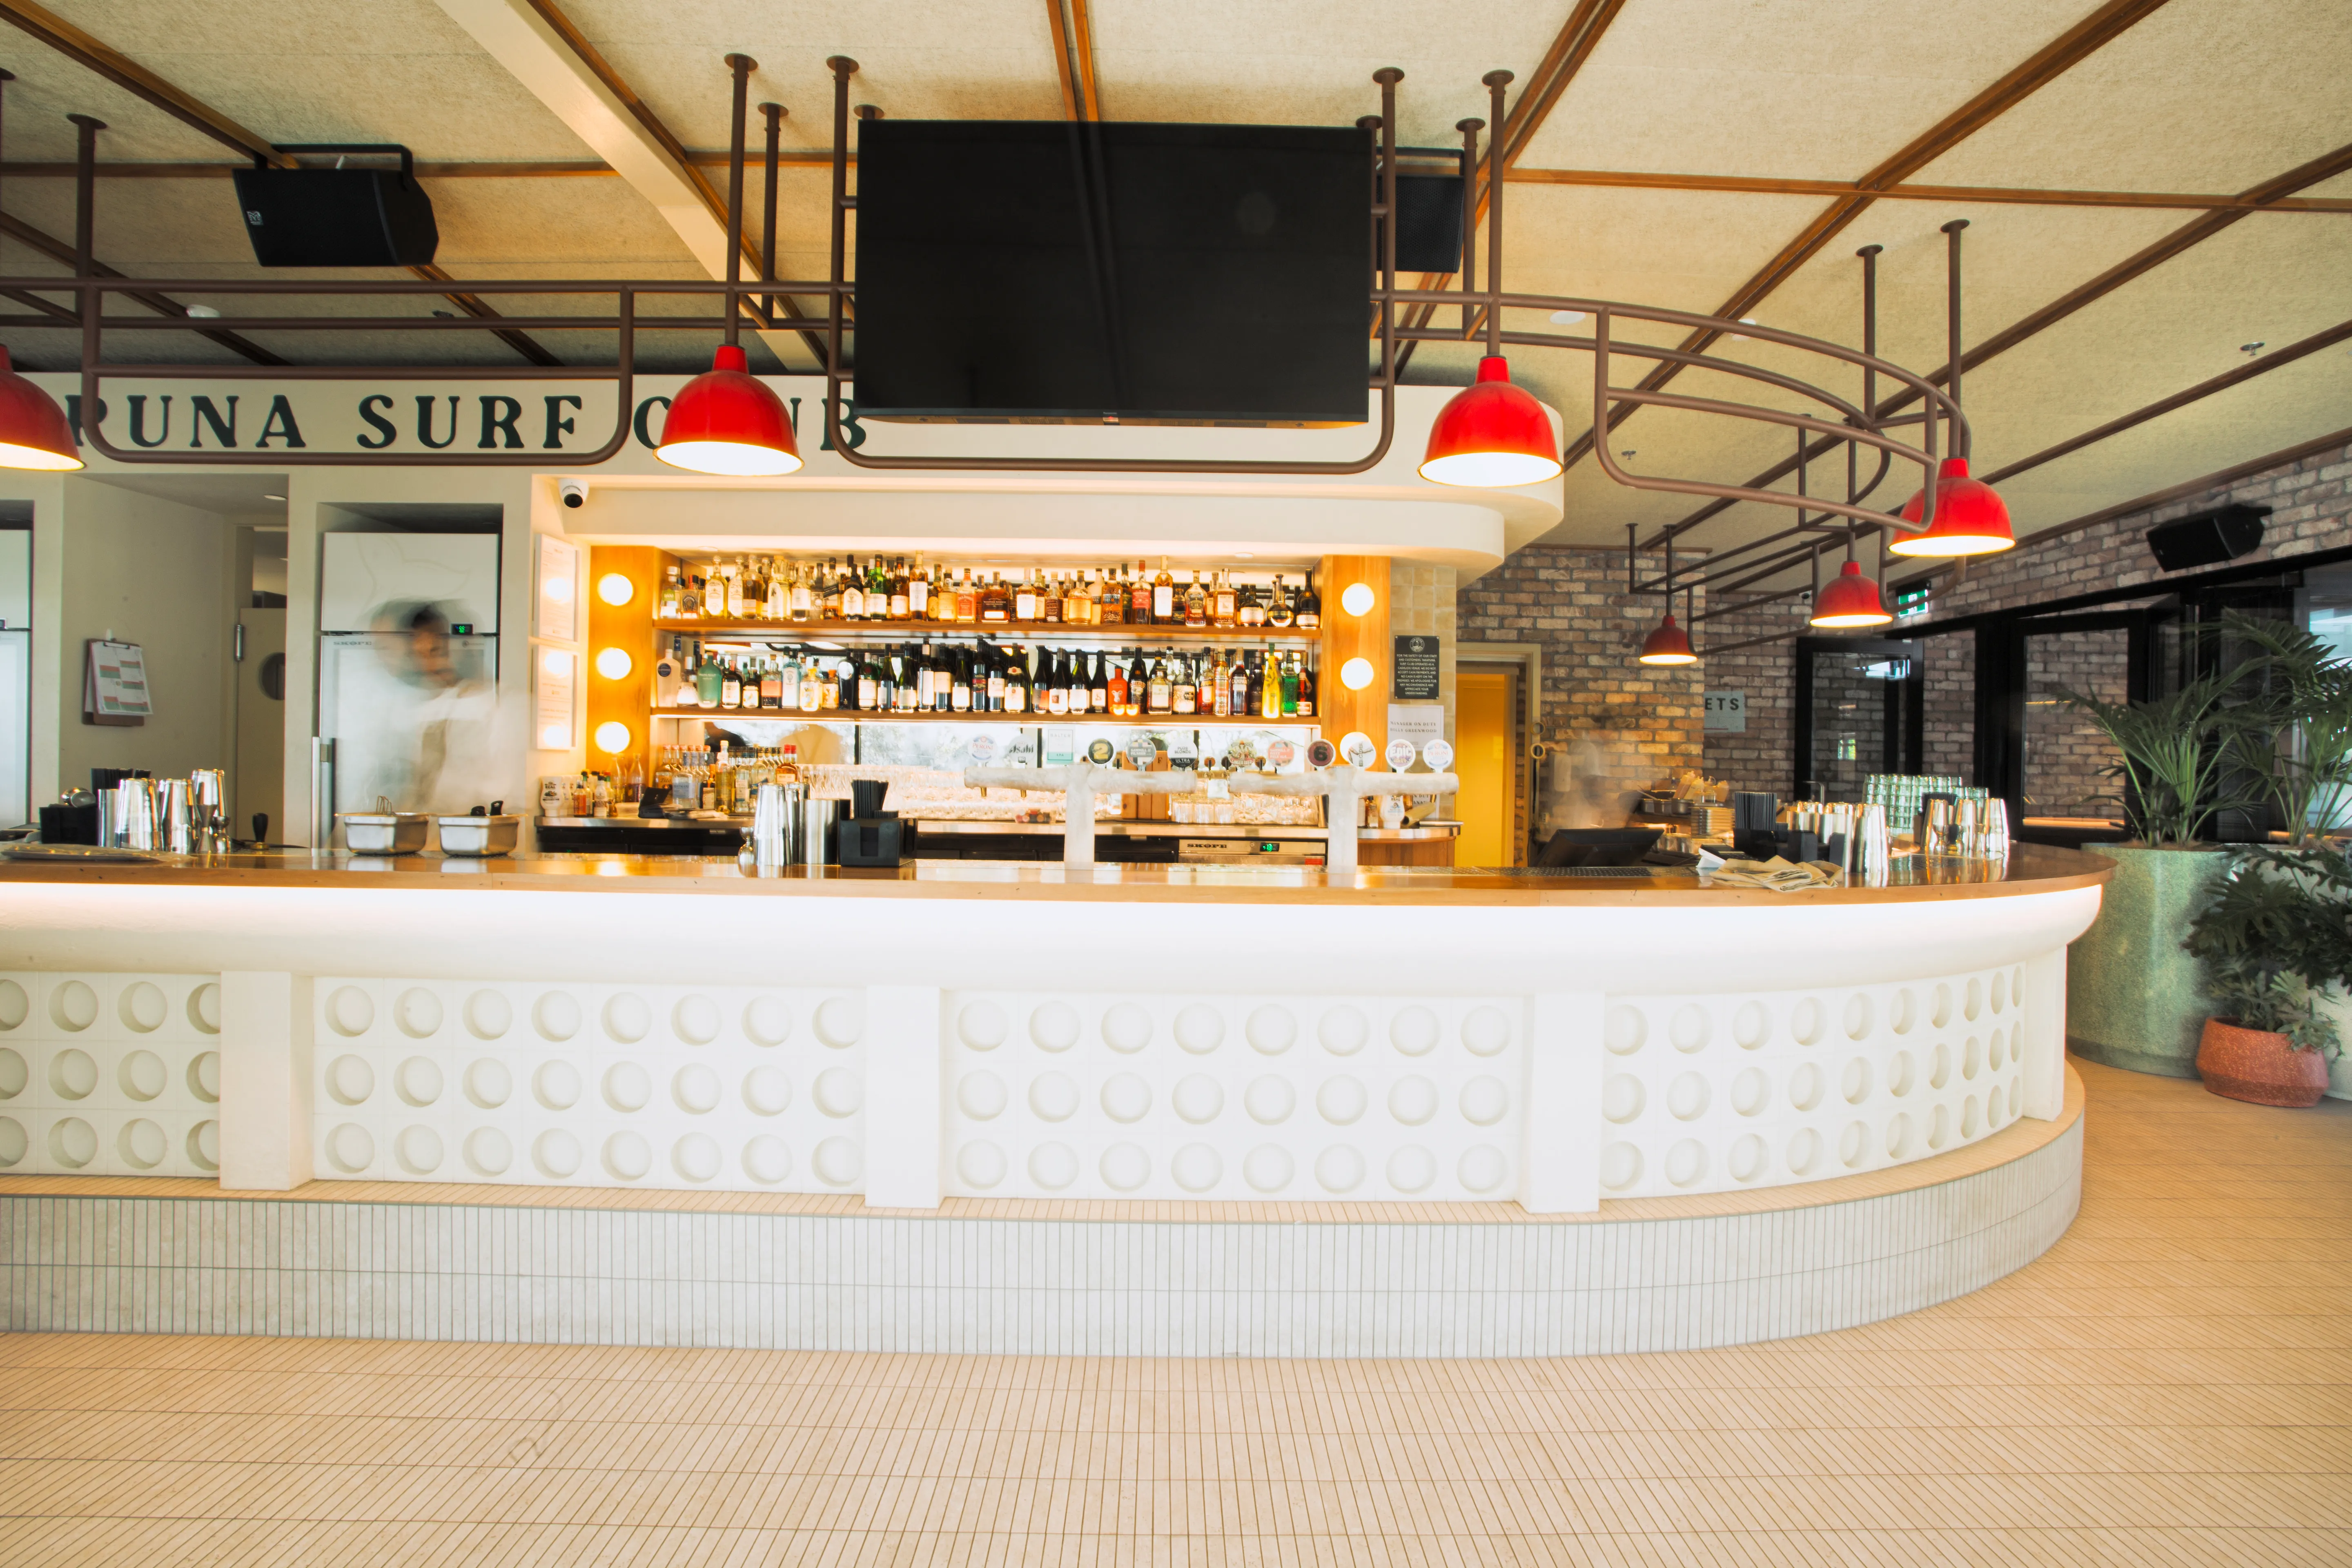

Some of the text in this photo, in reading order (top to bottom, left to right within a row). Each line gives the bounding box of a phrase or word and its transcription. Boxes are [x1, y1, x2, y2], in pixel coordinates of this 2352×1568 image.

[357, 395, 581, 448] SURF
[1704, 697, 1739, 710] ETS
[1009, 744, 1034, 753] Asahi
[1093, 743, 1108, 759] 2
[1314, 746, 1327, 761] 6
